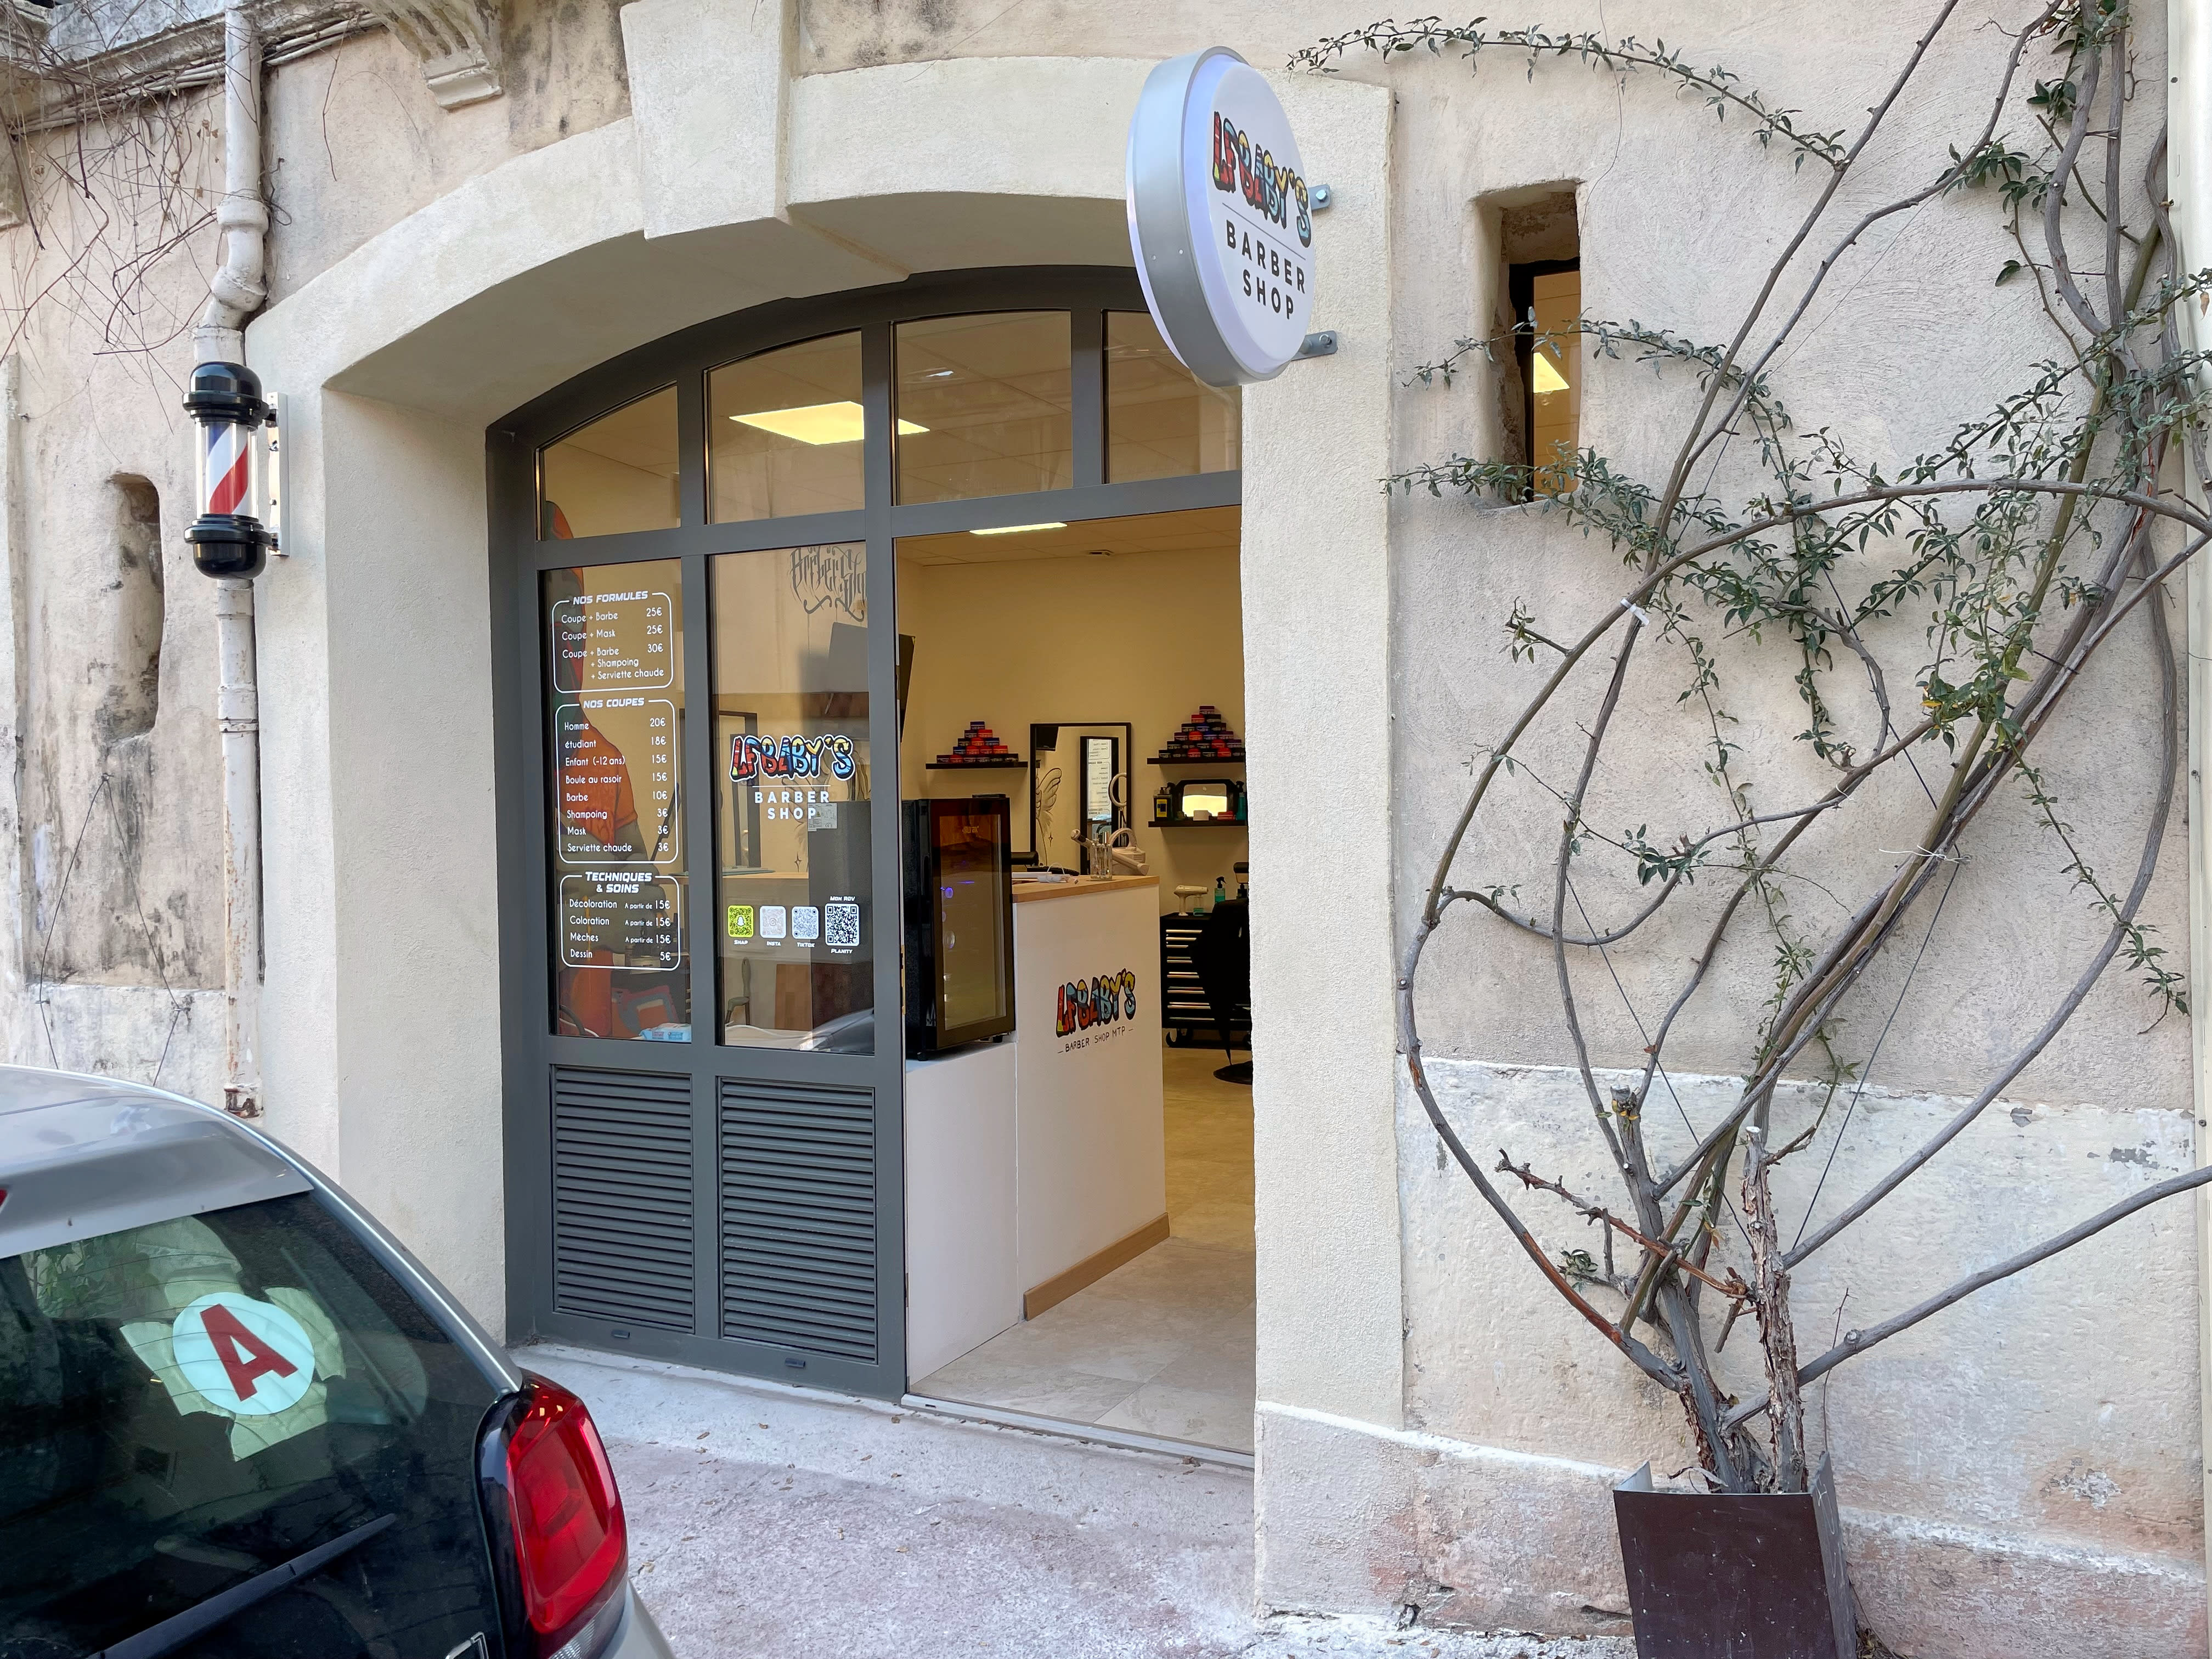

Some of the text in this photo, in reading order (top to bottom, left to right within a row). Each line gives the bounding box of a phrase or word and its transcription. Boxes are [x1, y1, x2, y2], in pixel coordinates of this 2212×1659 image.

[1226, 219, 1305, 294] BARBER
[1243, 268, 1294, 320] SHOP
[573, 591, 648, 605] NOS FORMULES
[561, 614, 586, 624] Coupe
[596, 612, 618, 620] Barbe
[646, 607, 662, 617] 25€
[562, 632, 587, 641] Coupe
[596, 629, 616, 638] Mask
[647, 625, 663, 634] 25€
[562, 650, 587, 659] Coupe
[597, 647, 619, 656] Barbe
[647, 644, 663, 652] 30€
[597, 658, 639, 668] Shampoing
[598, 670, 631, 680] Serviette
[635, 668, 664, 678] chaude
[584, 698, 644, 708] NOS COUPES
[565, 718, 666, 731] Homme 20€
[565, 736, 666, 748] étudiant 18€
[566, 754, 667, 766] Enfant (-12 ans) 15€
[566, 775, 585, 785] Boule
[652, 772, 667, 781] 15€
[567, 791, 667, 802] Barbe 10€
[755, 791, 829, 803] BARBER
[567, 808, 668, 820] Shampoing 3€
[768, 808, 816, 820] SHOP
[567, 825, 668, 835] Mask 3€
[568, 842, 668, 852] Serviette chaude 3€
[585, 871, 652, 882] TECHNIQUES
[596, 884, 639, 893] & SOINS
[569, 899, 617, 908] Décoloration
[655, 900, 670, 909] 15€
[570, 916, 610, 925] Coloration
[656, 918, 670, 927] 15€
[571, 933, 598, 942] Mèches
[656, 935, 670, 944] 15€
[571, 949, 670, 961] Dessin 5€
[1065, 1026, 1125, 1052] BARBER SHOP MTP
[200, 1304, 297, 1401] A
